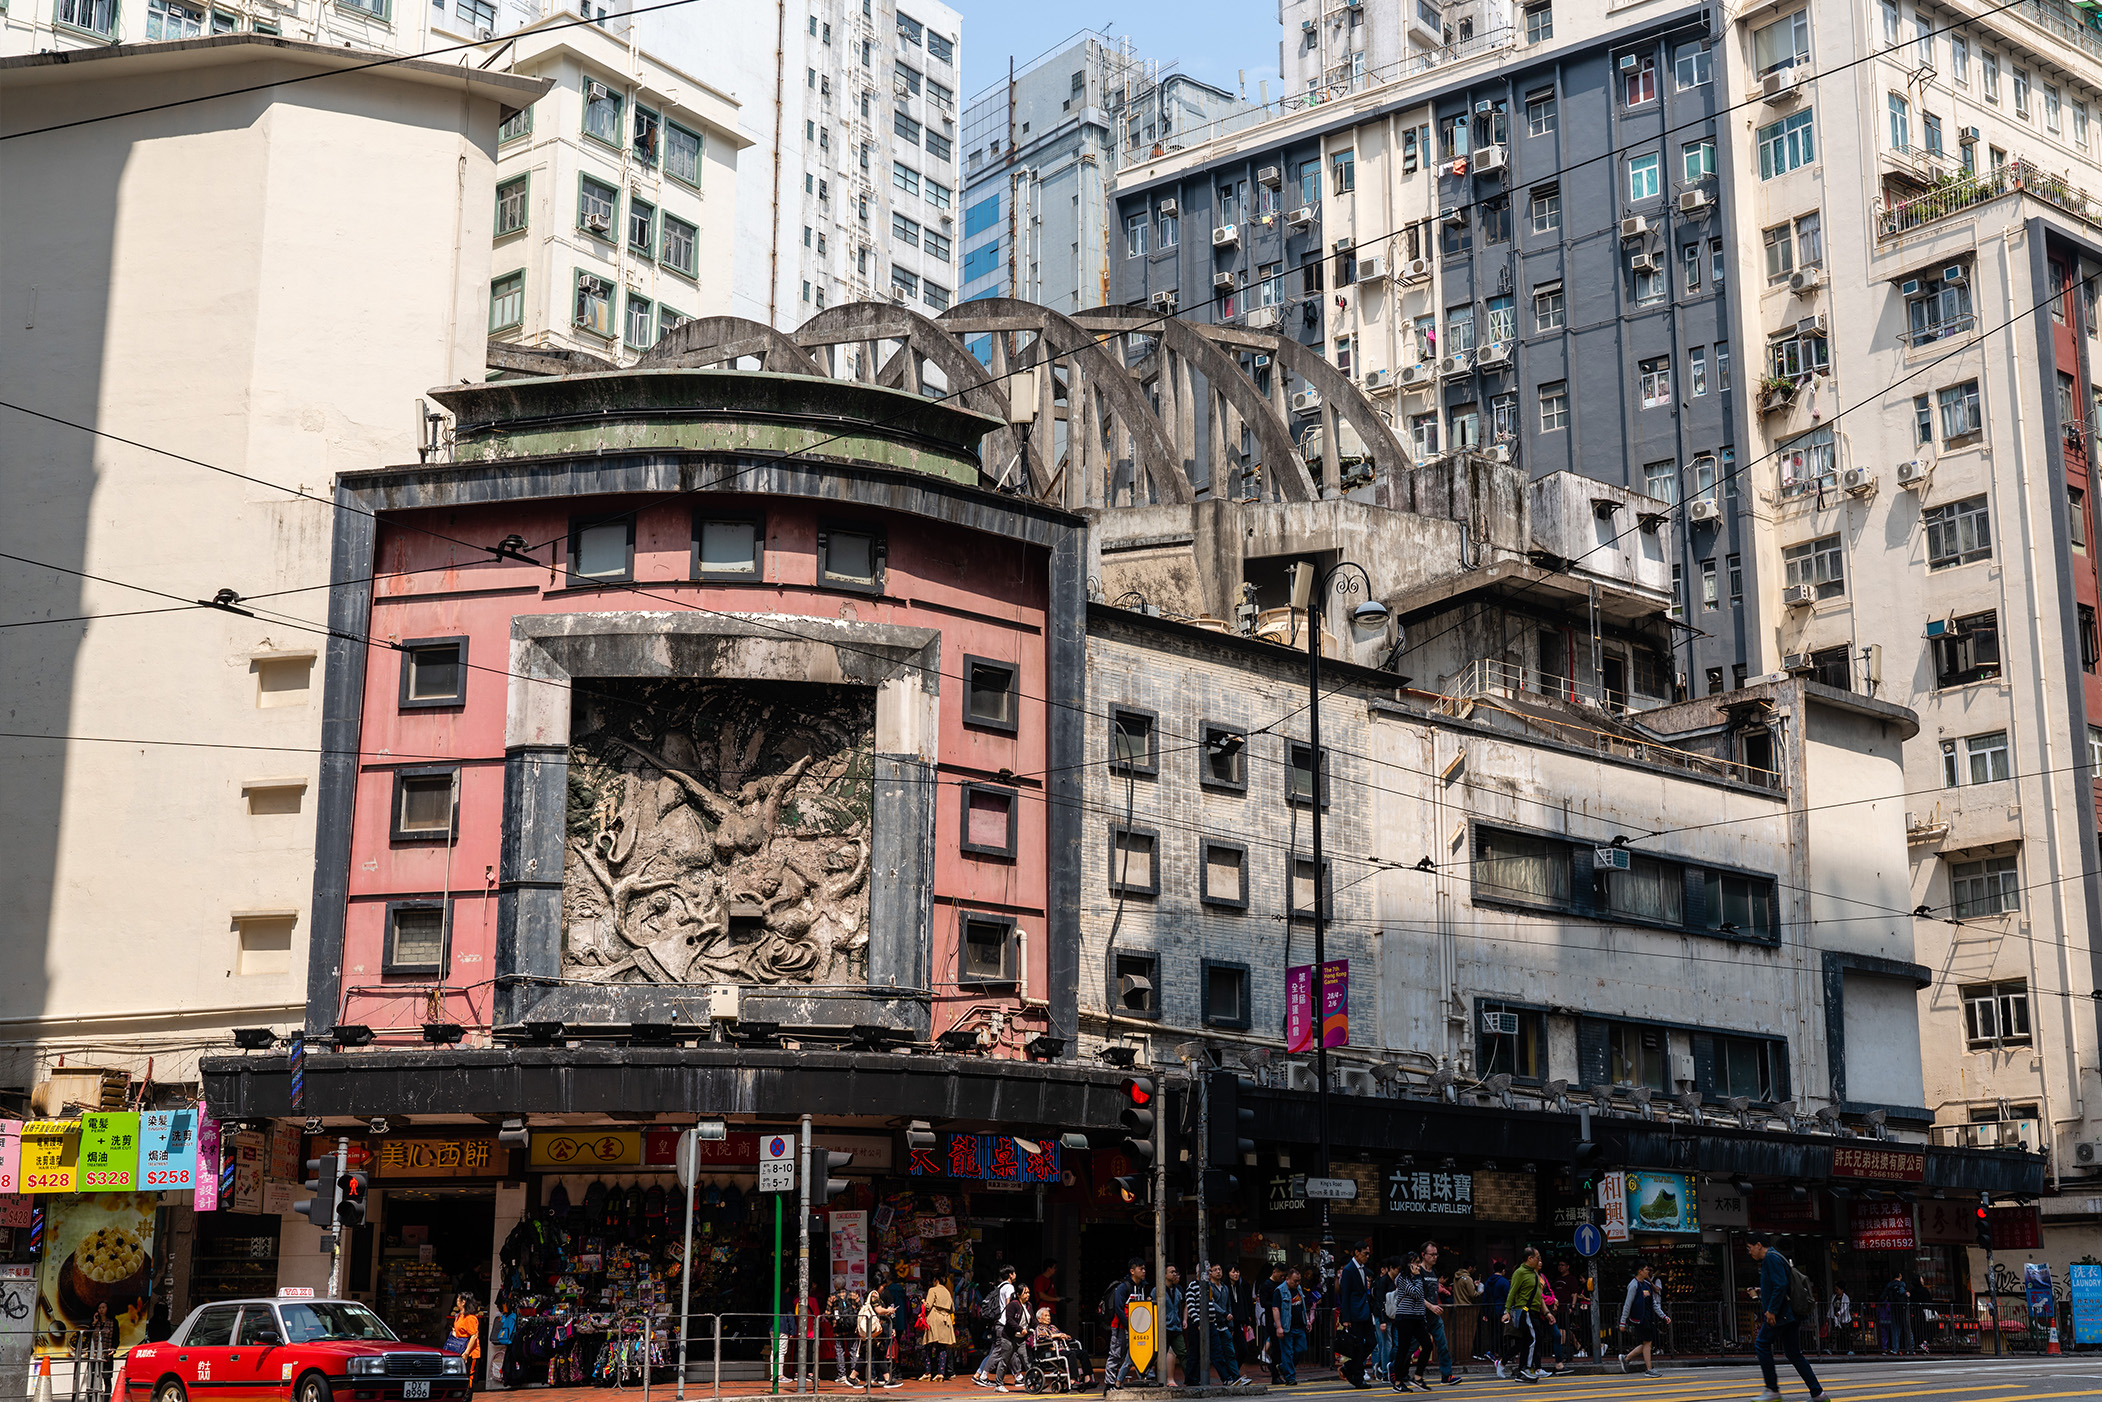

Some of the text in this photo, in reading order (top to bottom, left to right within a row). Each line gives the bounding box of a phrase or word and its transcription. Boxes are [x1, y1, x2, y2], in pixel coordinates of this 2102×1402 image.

[1298, 973, 1306, 1005] 第七屆
[1292, 983, 1300, 1037] 全港運動會
[88, 1117, 108, 1129] 電髮
[148, 1115, 167, 1126] 染髮
[110, 1134, 132, 1146] 洗剪
[172, 1130, 192, 1141] 洗剪
[87, 1151, 108, 1162] 焗油
[147, 1150, 169, 1161] 焗油
[381, 1141, 489, 1168] 美心西餅
[1834, 1149, 1924, 1173] 許氏兄弟找換有限公司
[772, 1163, 793, 1173] 8-10
[27, 1173, 70, 1188] $428
[86, 1171, 130, 1186] $328
[147, 1170, 190, 1184] $258
[1869, 1170, 1904, 1180] 25661592
[772, 1178, 790, 1188] 5-7
[1389, 1169, 1472, 1202] 六福珠寶
[1269, 1199, 1305, 1211] LUKFOOK
[1390, 1201, 1472, 1214] LUKFOOK JEWELLERY
[1602, 1175, 1624, 1228] 和興
[1715, 1196, 1741, 1212] 大不同
[1857, 1201, 1903, 1216] 許氏兄弟
[9, 1210, 28, 1224] $428
[1869, 1237, 1914, 1249] 25661592
[2073, 1266, 2099, 1278] 洗衣
[2072, 1279, 2102, 1287] LAUNDRY
[284, 1288, 312, 1296] TAXI
[198, 1361, 211, 1370] 的士
[197, 1371, 211, 1380] TAXI
[411, 1381, 423, 1390] DX
[406, 1390, 428, 1398] 8996
